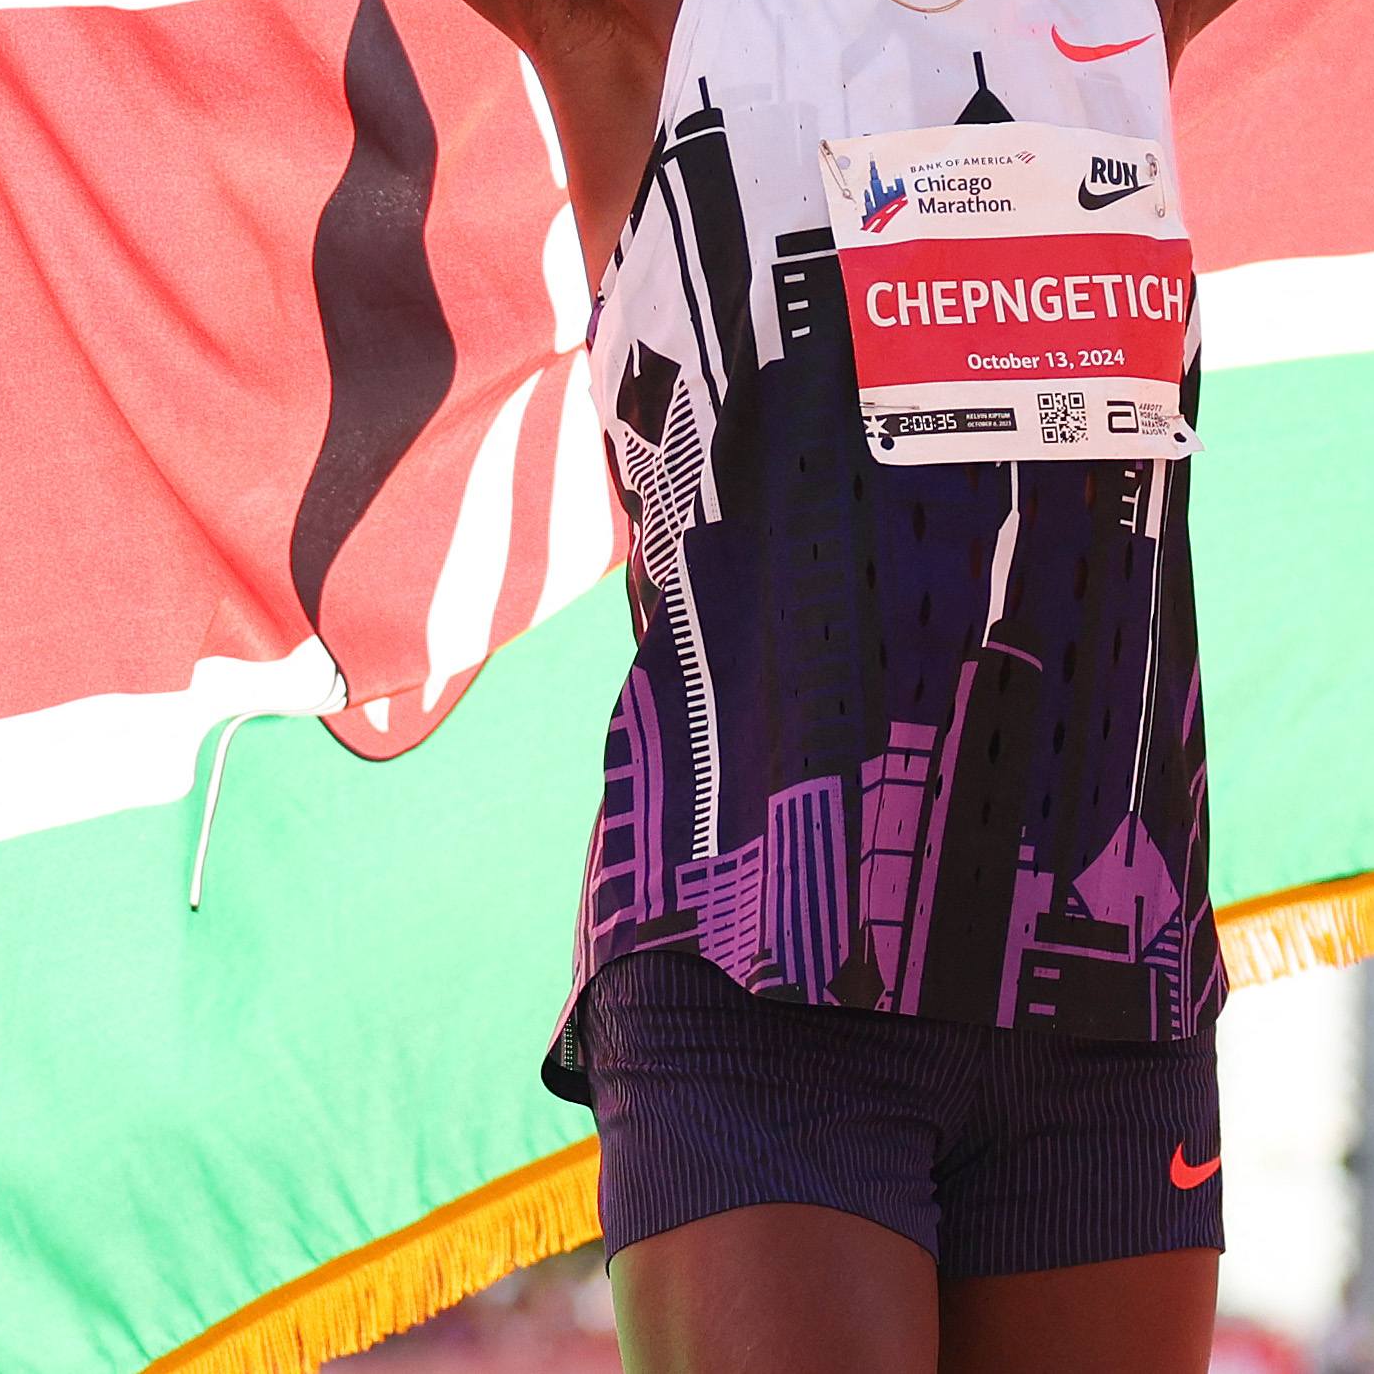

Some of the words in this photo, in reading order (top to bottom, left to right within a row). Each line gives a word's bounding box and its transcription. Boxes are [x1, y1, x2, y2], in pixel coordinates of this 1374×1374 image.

[910, 161, 942, 173] BANK
[946, 159, 960, 167] OF
[963, 156, 1013, 166] AMERICA
[1090, 156, 1139, 187] RUN
[914, 174, 992, 196] Chicago
[866, 274, 1183, 327] CHEPNGETICH
[967, 353, 1041, 370] October
[1045, 352, 1074, 370] 13,
[1077, 349, 1125, 367] 2024
[899, 413, 957, 433] 2:00:35
